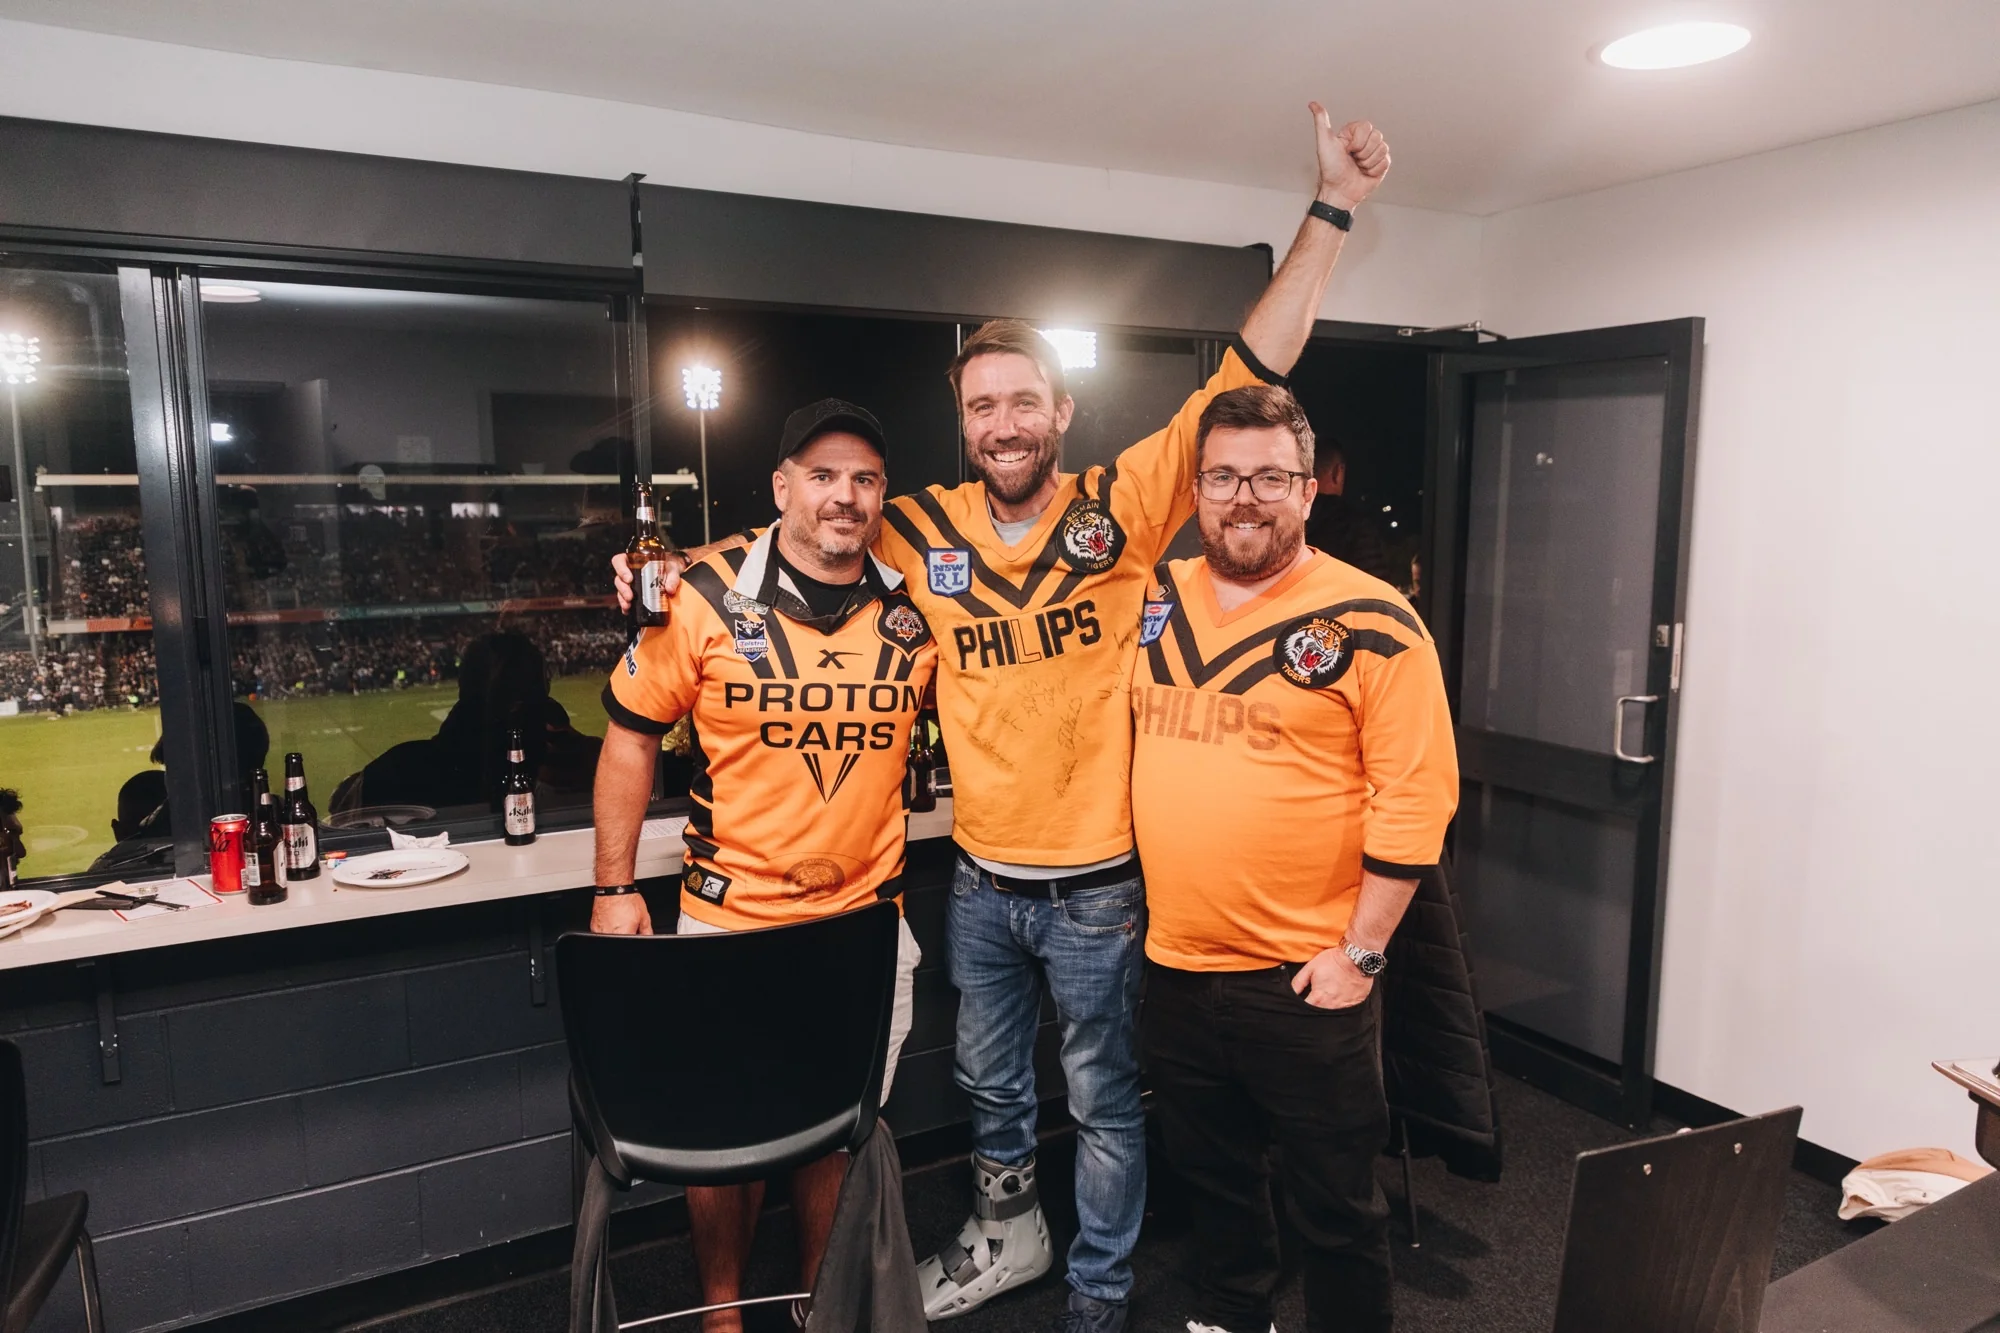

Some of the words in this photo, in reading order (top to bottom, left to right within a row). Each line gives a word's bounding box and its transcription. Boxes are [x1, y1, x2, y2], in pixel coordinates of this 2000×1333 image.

[1066, 502, 1100, 522] BALMAIN
[932, 564, 965, 572] NSW
[1085, 556, 1115, 569] TIGERS
[952, 599, 1102, 671] PHILIPS
[1312, 617, 1350, 639] BALMAIN
[1281, 662, 1312, 685] TIGERS
[724, 682, 924, 713] PROTON
[760, 721, 896, 751] CARS
